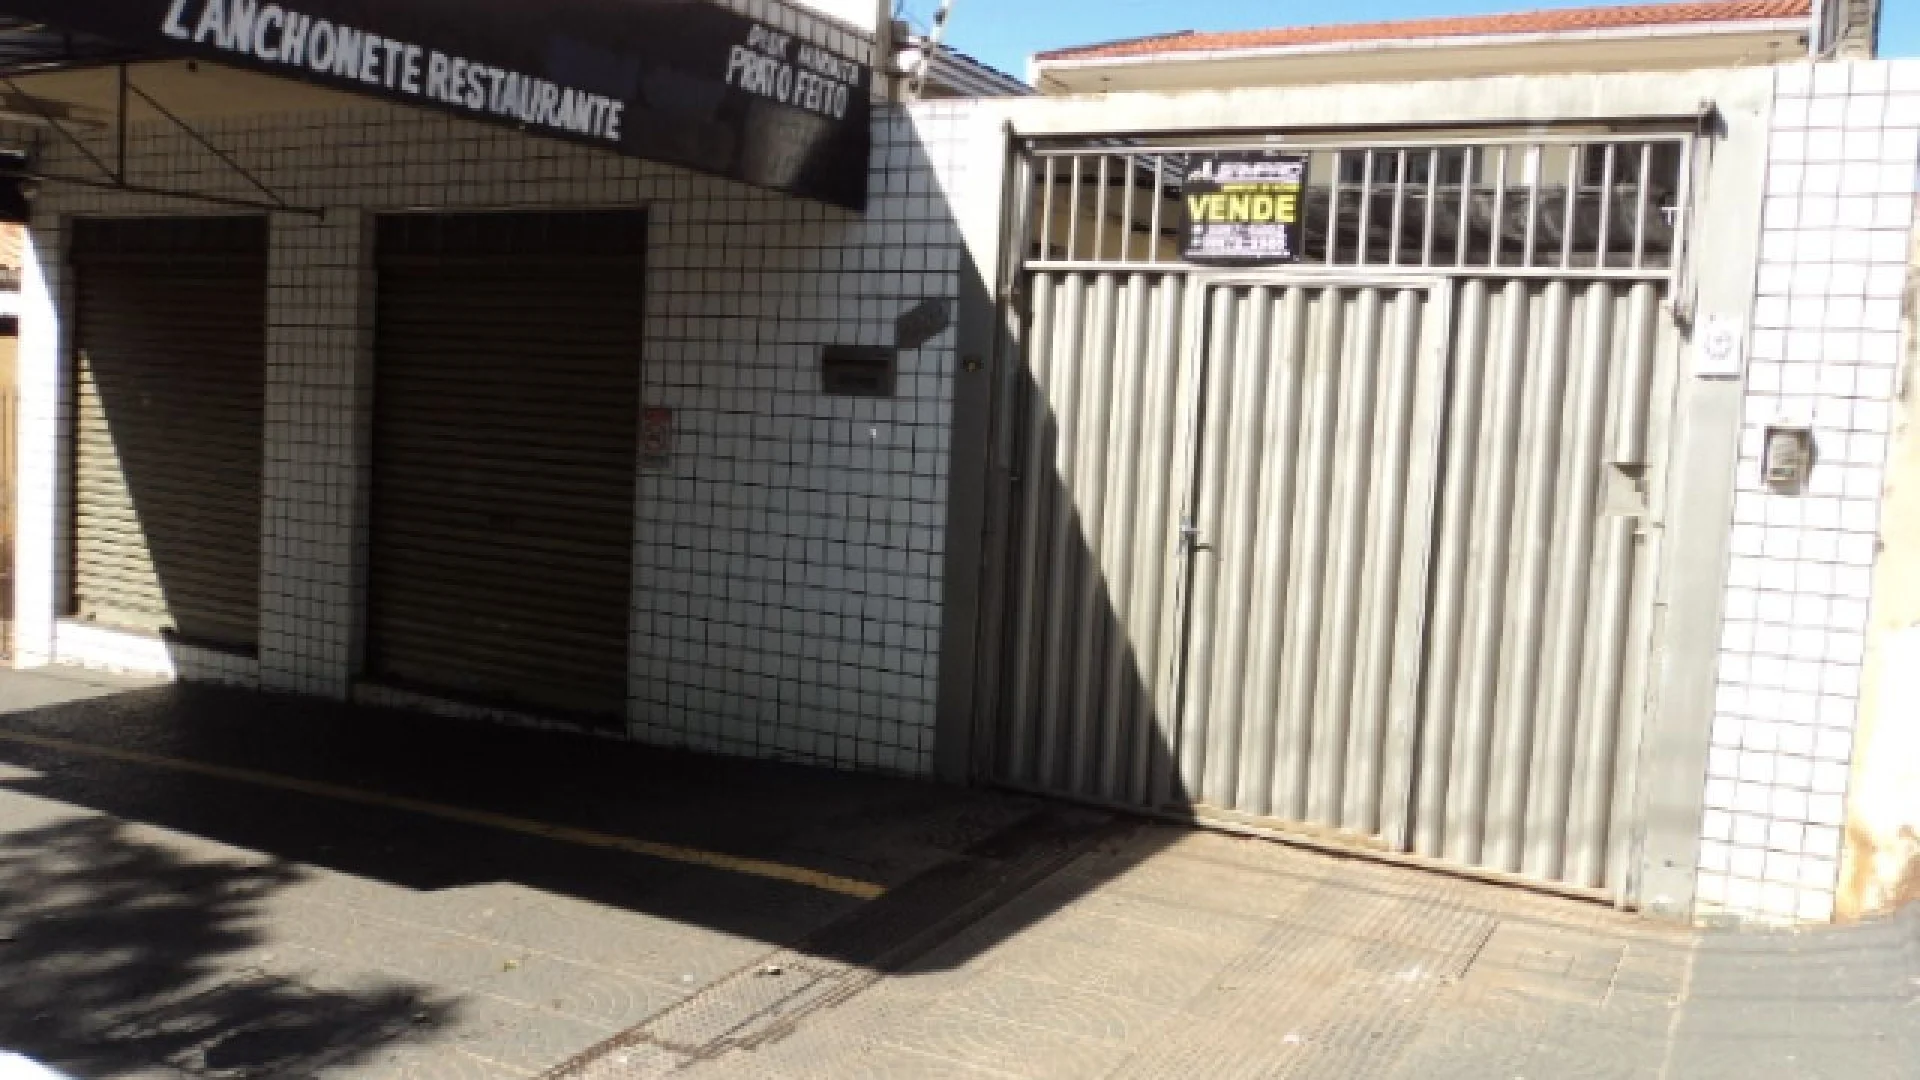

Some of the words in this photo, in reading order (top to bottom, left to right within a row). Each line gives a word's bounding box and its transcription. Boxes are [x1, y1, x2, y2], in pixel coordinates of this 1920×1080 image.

[162, 0, 422, 95] LANCHONETE
[427, 50, 625, 142] RESTAURANTE
[793, 71, 848, 120] FEITO
[1187, 194, 1296, 222] VENDE
